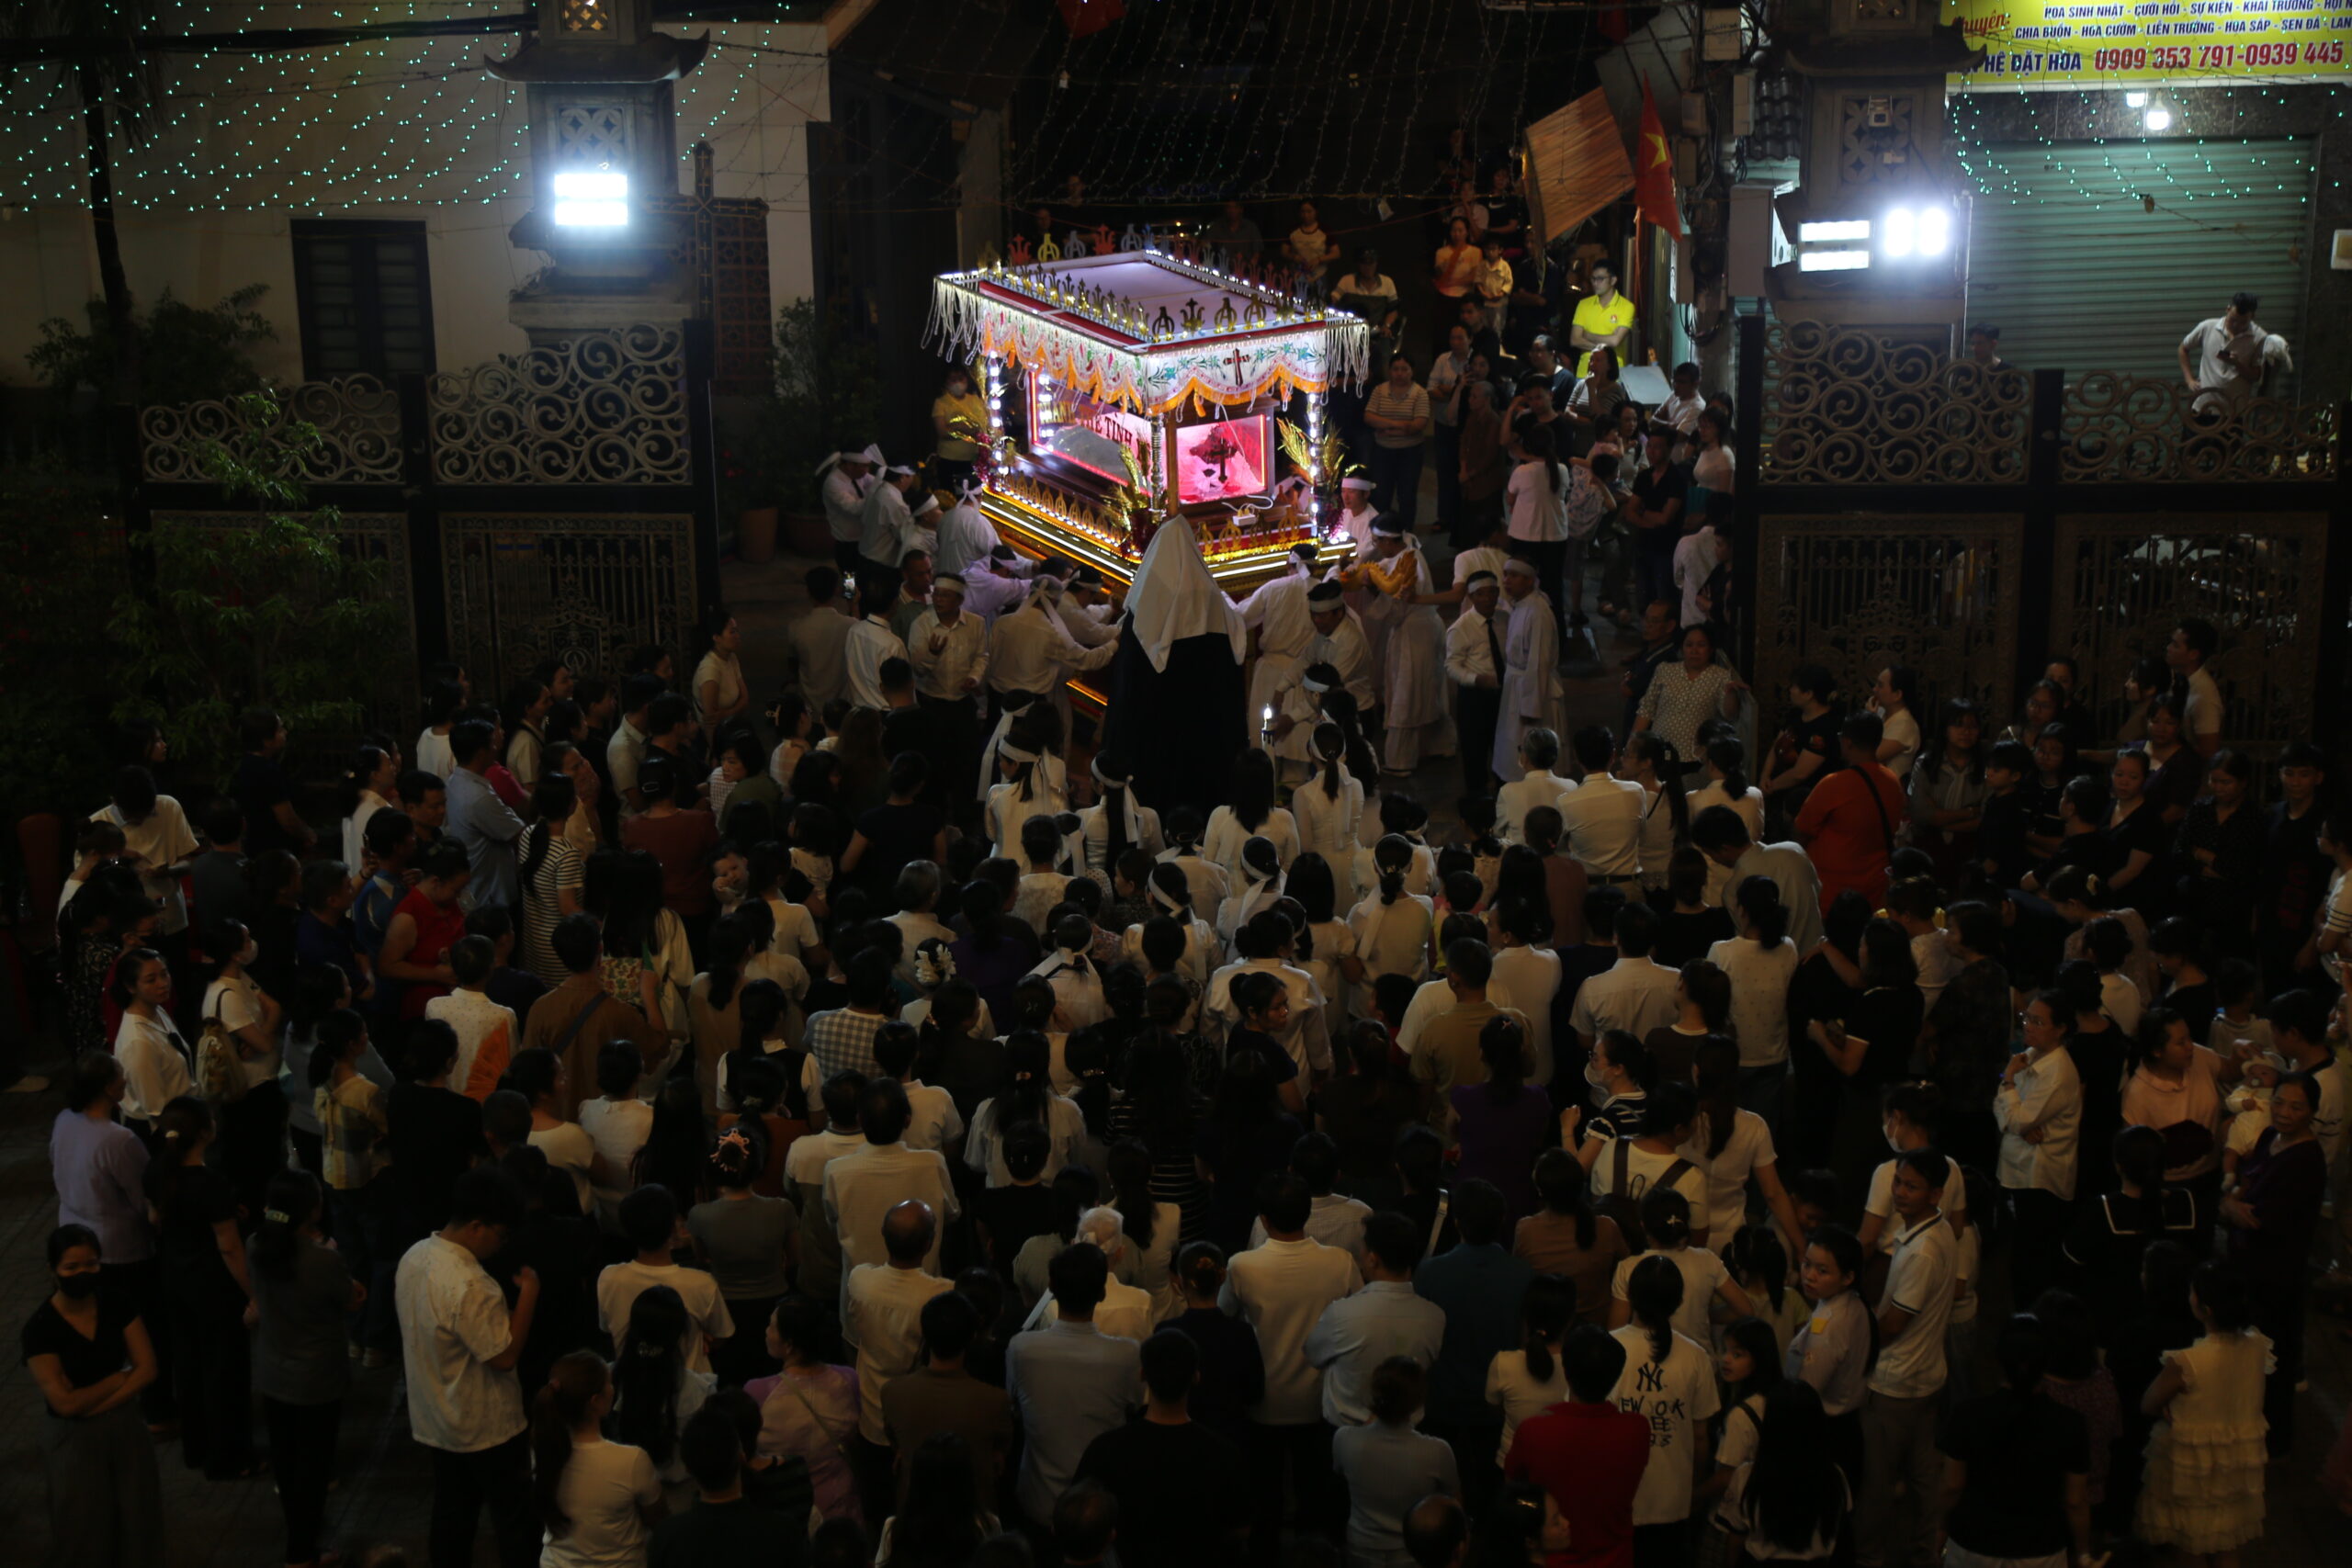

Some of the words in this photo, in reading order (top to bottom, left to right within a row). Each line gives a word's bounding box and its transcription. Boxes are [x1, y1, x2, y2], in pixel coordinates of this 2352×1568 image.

[2044, 6, 2064, 18] HOA
[2068, 6, 2094, 17] SINH
[2243, 0, 2268, 12] KHAI
[2015, 26, 2040, 39] CHIA
[2081, 25, 2102, 37] HOA
[2225, 20, 2246, 33] HOA
[2281, 17, 2303, 30] SEN
[2048, 51, 2082, 72] HOA
[2095, 48, 2147, 71] 0909
[2152, 47, 2192, 70] 353
[2199, 43, 2298, 67] 791-0939
[2303, 41, 2344, 65] 445
